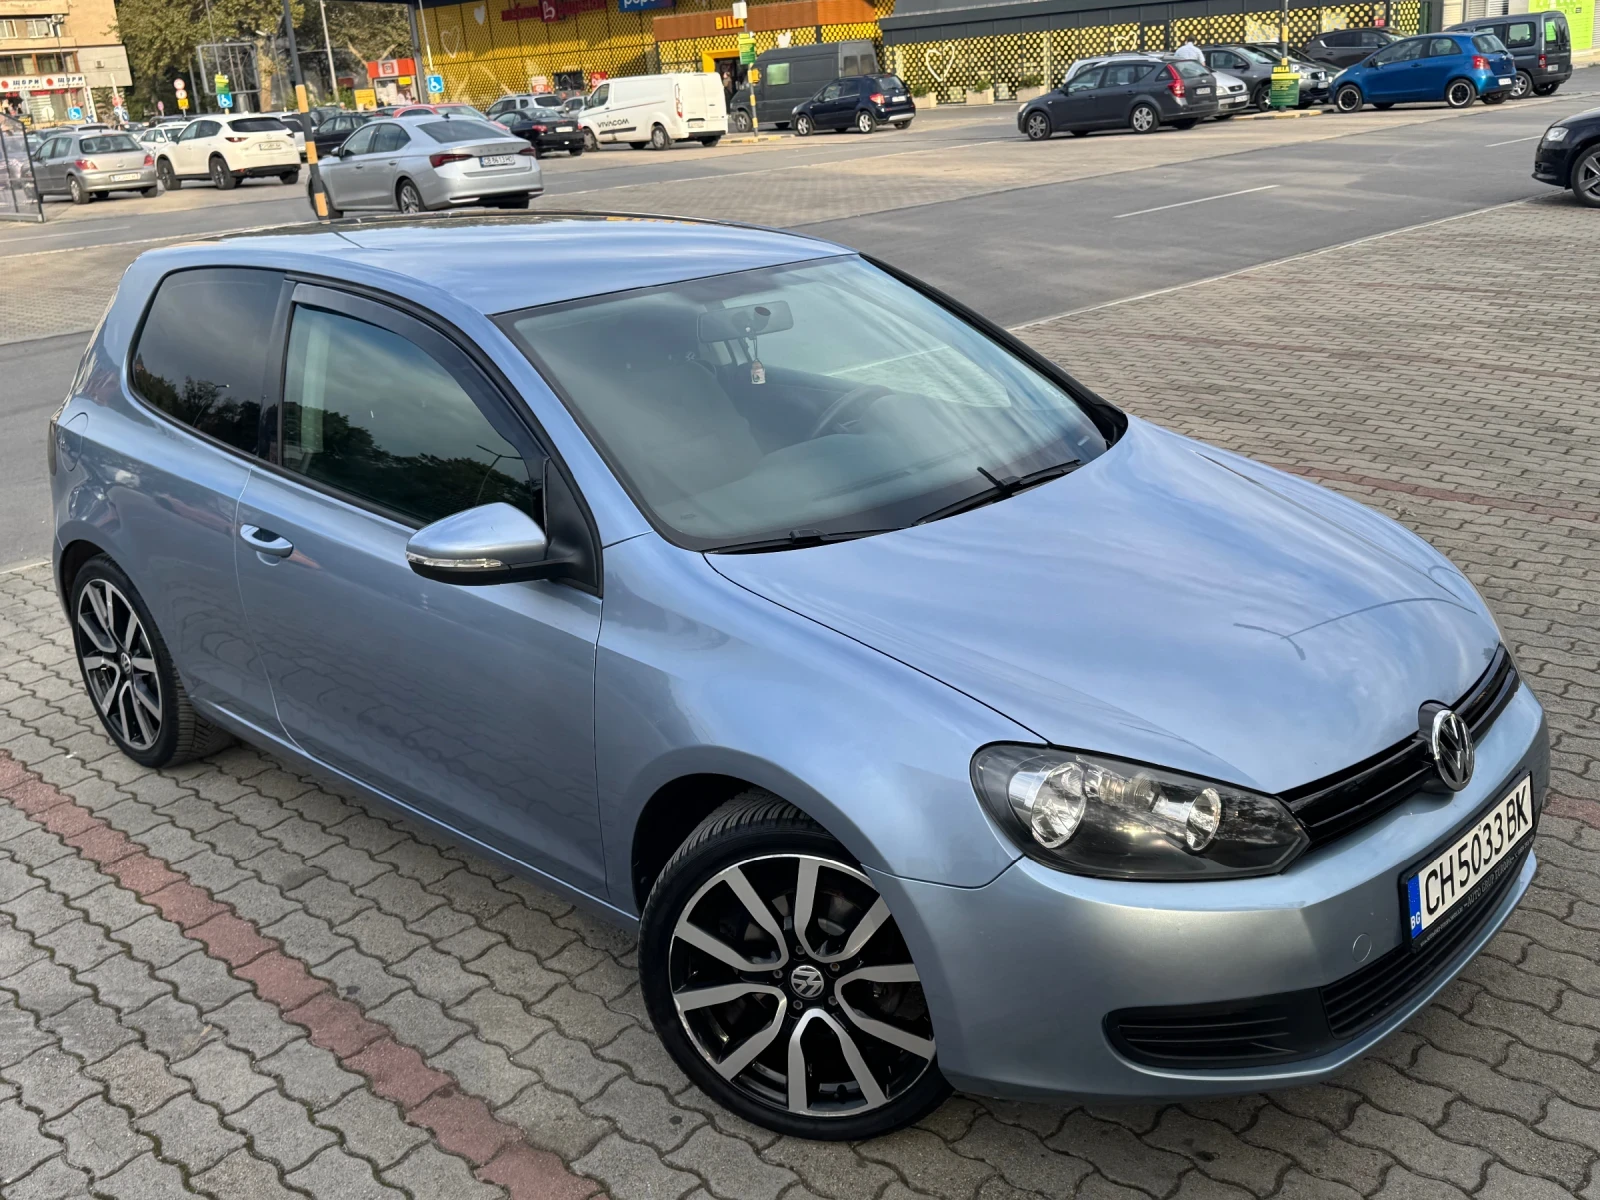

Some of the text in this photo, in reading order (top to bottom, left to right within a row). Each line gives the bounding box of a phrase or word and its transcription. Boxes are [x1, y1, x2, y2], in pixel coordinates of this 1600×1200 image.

[715, 16, 745, 30] BILLA
[597, 118, 630, 128] VIVACOM
[1410, 911, 1421, 930] BG
